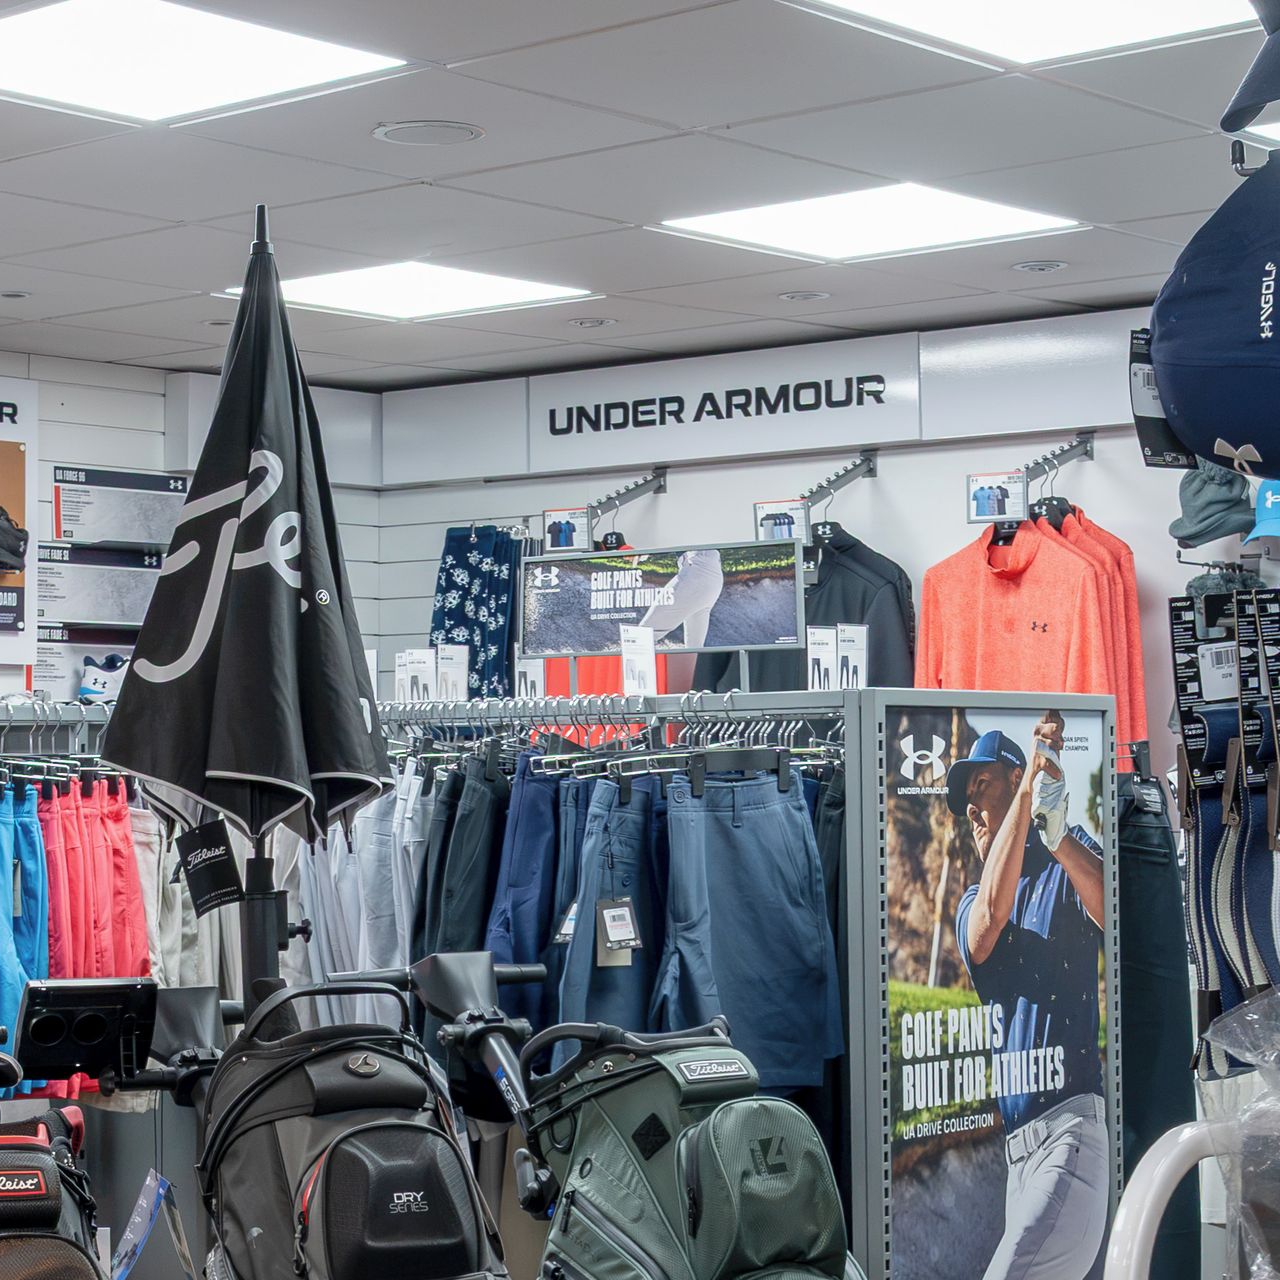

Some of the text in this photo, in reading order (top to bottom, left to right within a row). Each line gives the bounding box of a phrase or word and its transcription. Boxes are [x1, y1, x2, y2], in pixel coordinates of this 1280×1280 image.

[549, 374, 886, 436] UNDER ARMOUR
[591, 570, 643, 591] GOLF PANTS
[590, 587, 675, 610] BUILT FOR ATHLETES
[897, 787, 949, 795] UNDER ARMOUR
[186, 846, 226, 869] Titleist
[902, 1003, 1004, 1060] GOLF PANTS
[690, 1062, 740, 1076] Titleist
[902, 1045, 1065, 1112] BUILT FOR ATHLETES
[903, 1113, 994, 1140] UA DRIVE COLLECTION
[389, 1202, 429, 1214] SERIES
[393, 1191, 424, 1203] DRY
